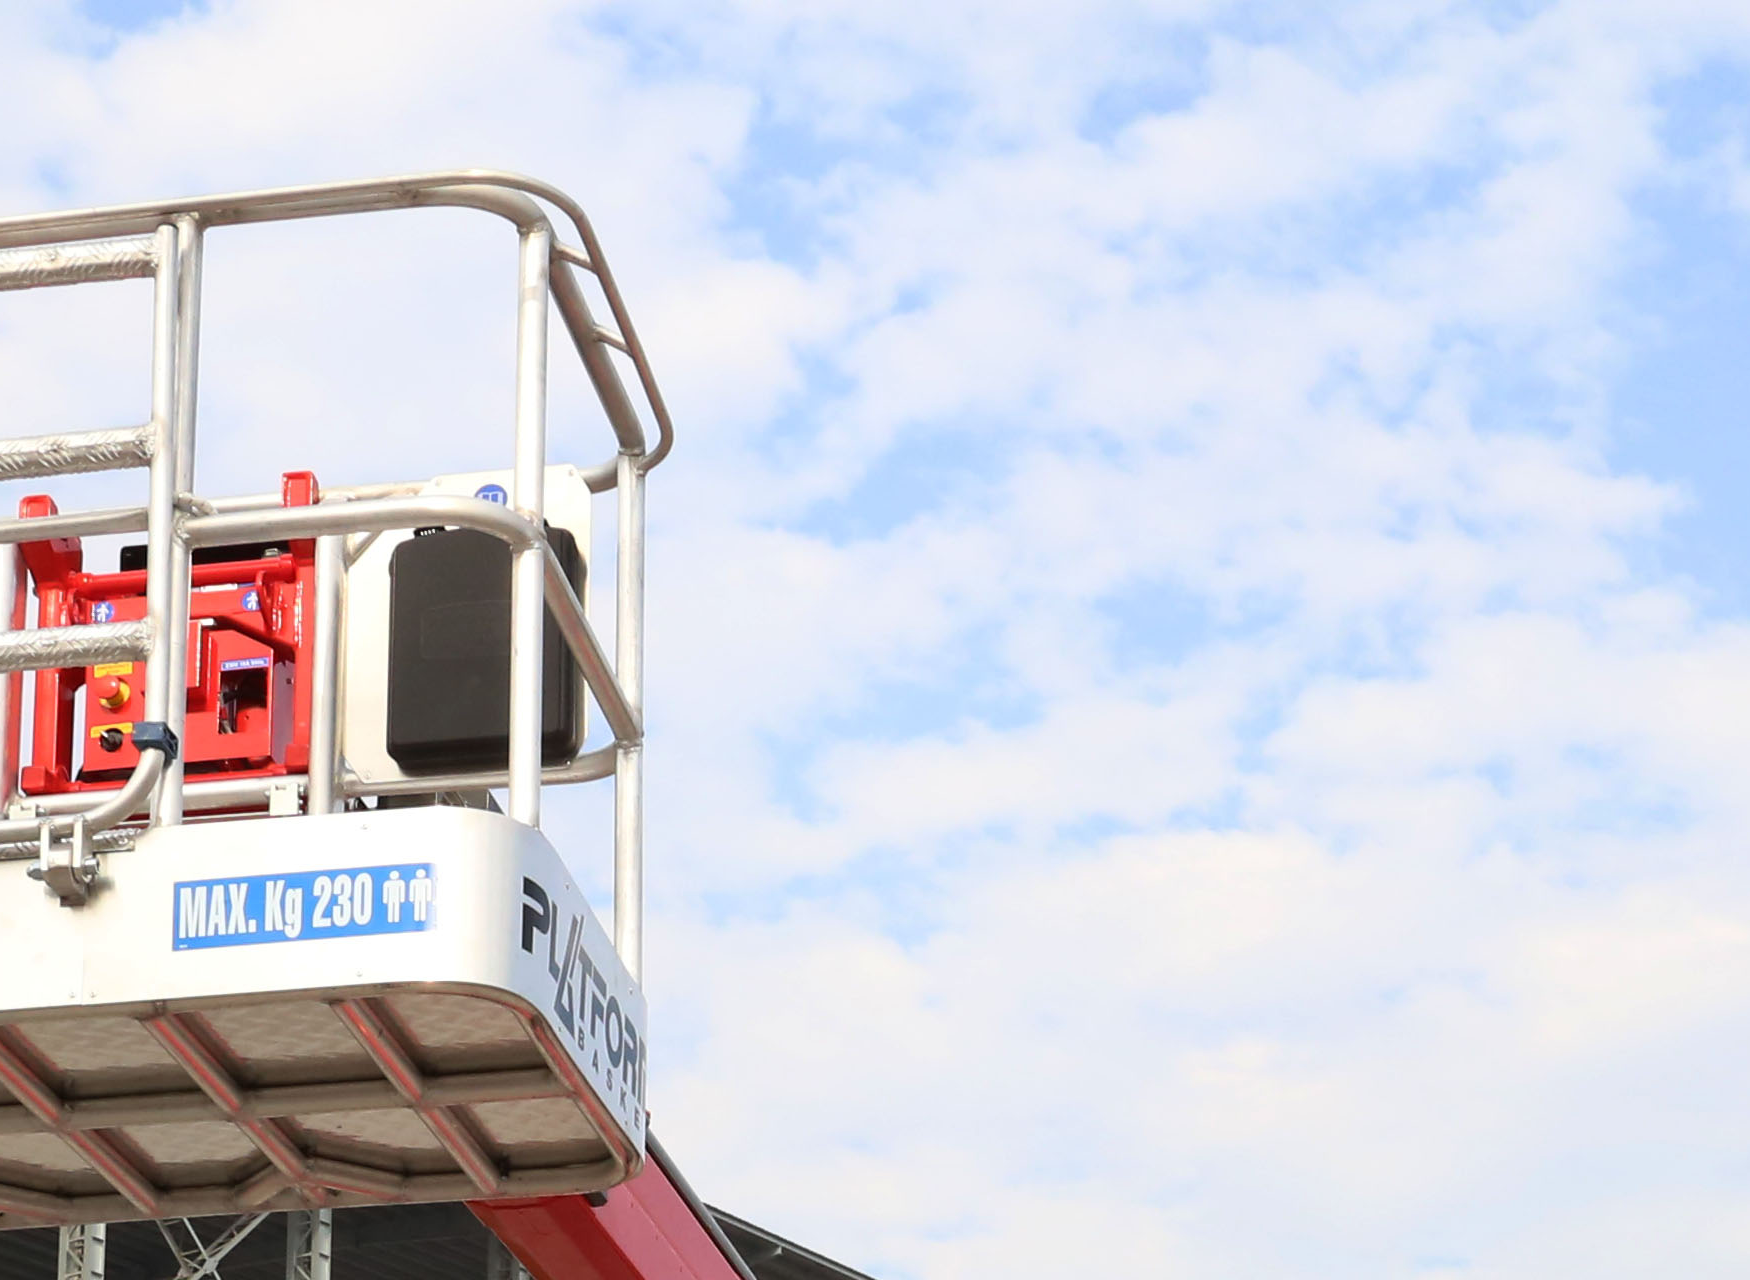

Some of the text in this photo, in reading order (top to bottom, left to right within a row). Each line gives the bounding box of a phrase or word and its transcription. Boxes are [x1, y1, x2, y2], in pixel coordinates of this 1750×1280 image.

[179, 872, 373, 939] MAX. Kg 230
